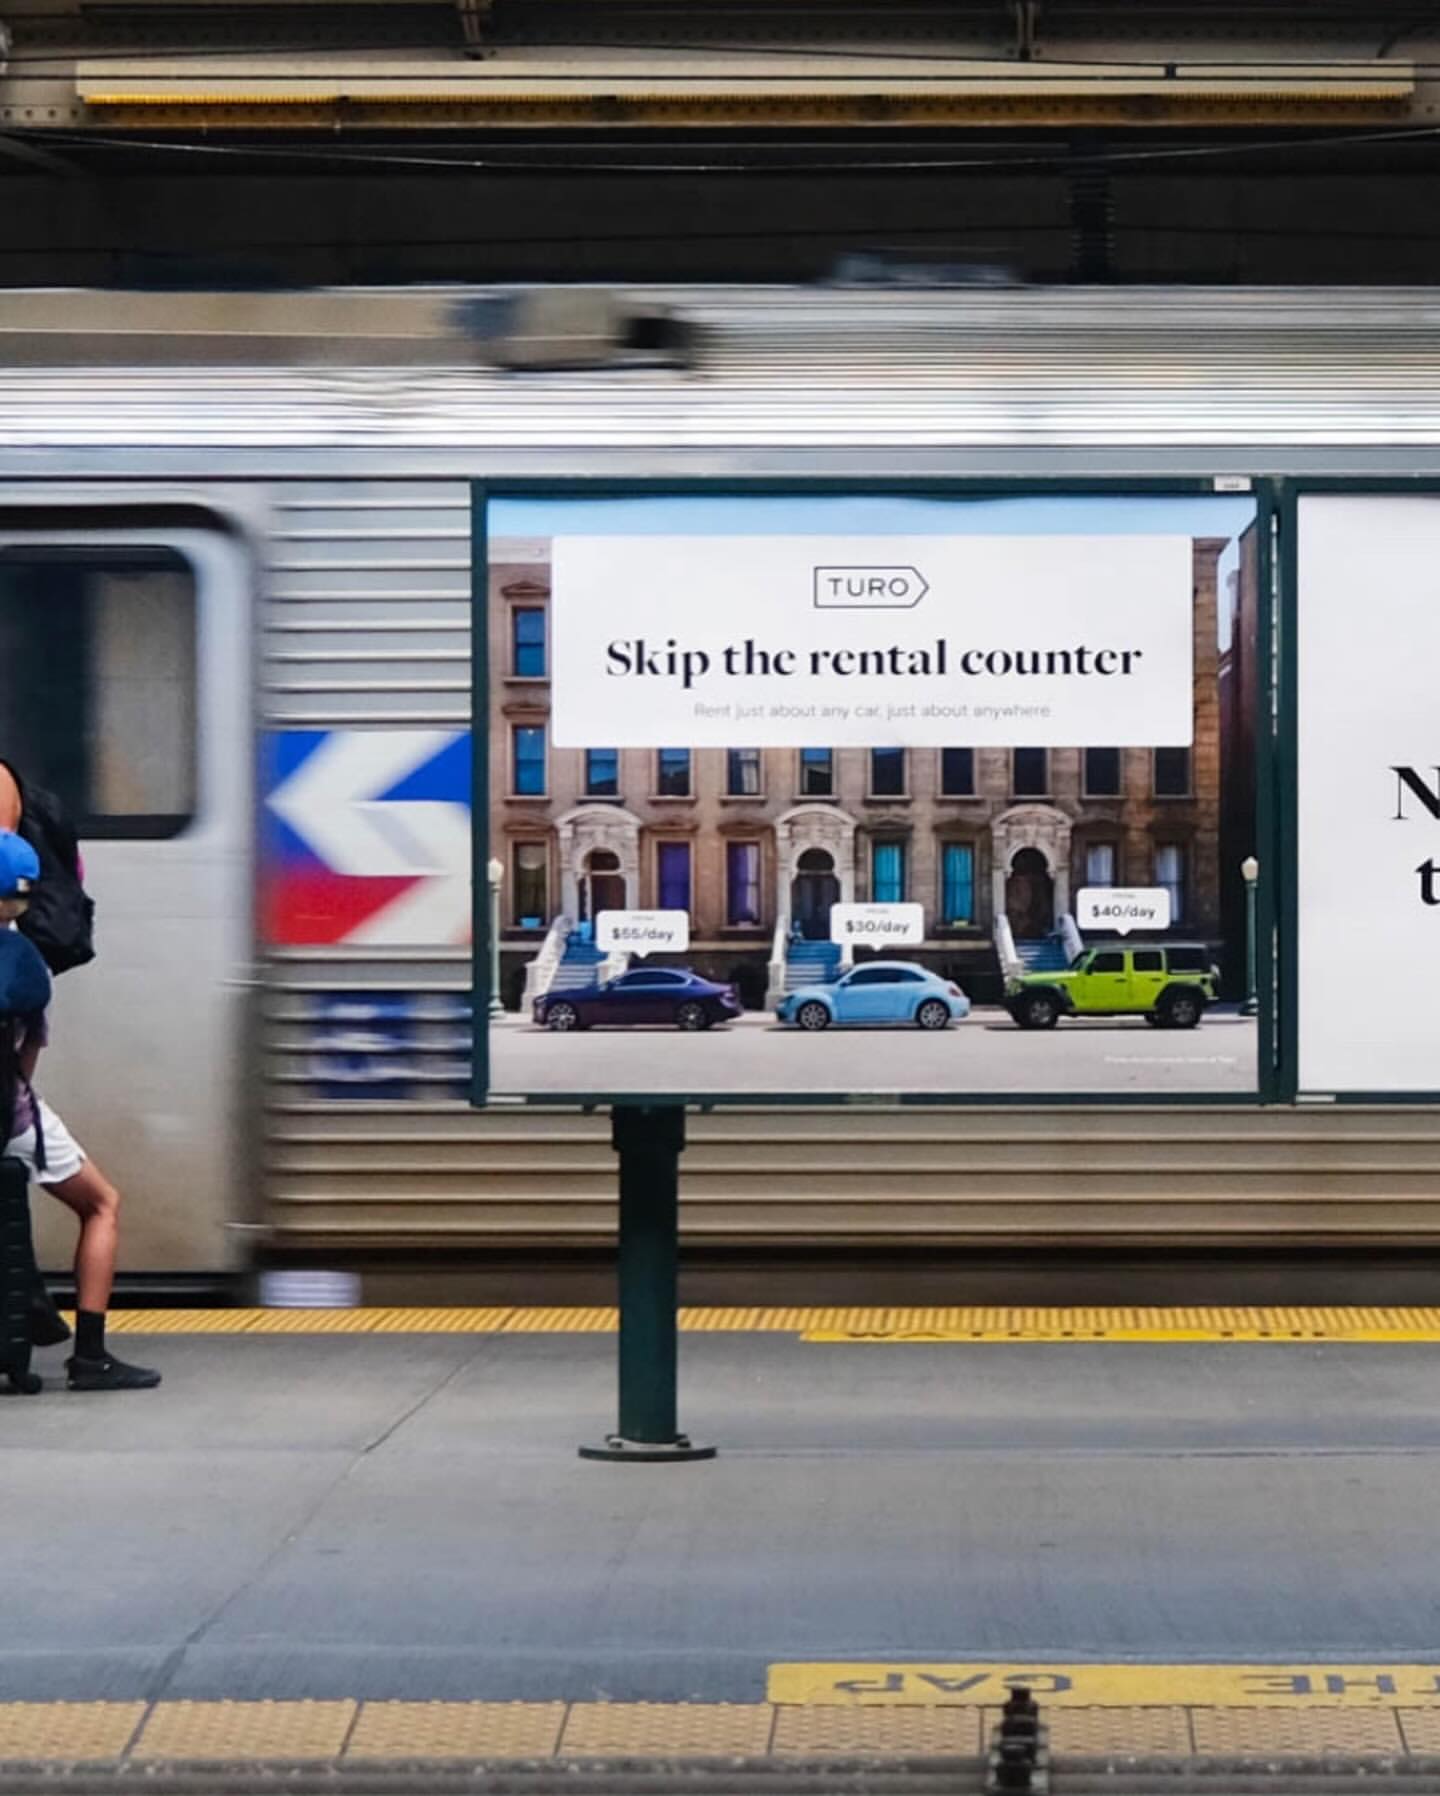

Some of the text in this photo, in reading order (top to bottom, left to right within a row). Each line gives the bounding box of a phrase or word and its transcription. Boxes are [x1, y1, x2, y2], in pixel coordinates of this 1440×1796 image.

[827, 577, 910, 598] TURO
[606, 638, 1144, 690] Skip the rental counter
[694, 703, 731, 718] Rent
[735, 703, 764, 721] just
[769, 703, 816, 718] about
[821, 706, 850, 721] any
[887, 703, 915, 721] just
[921, 703, 968, 718] about
[973, 704, 1051, 721] anywhere
[1091, 904, 1157, 920] $40/day
[612, 927, 674, 942] $55/day
[845, 920, 910, 936] $30/day
